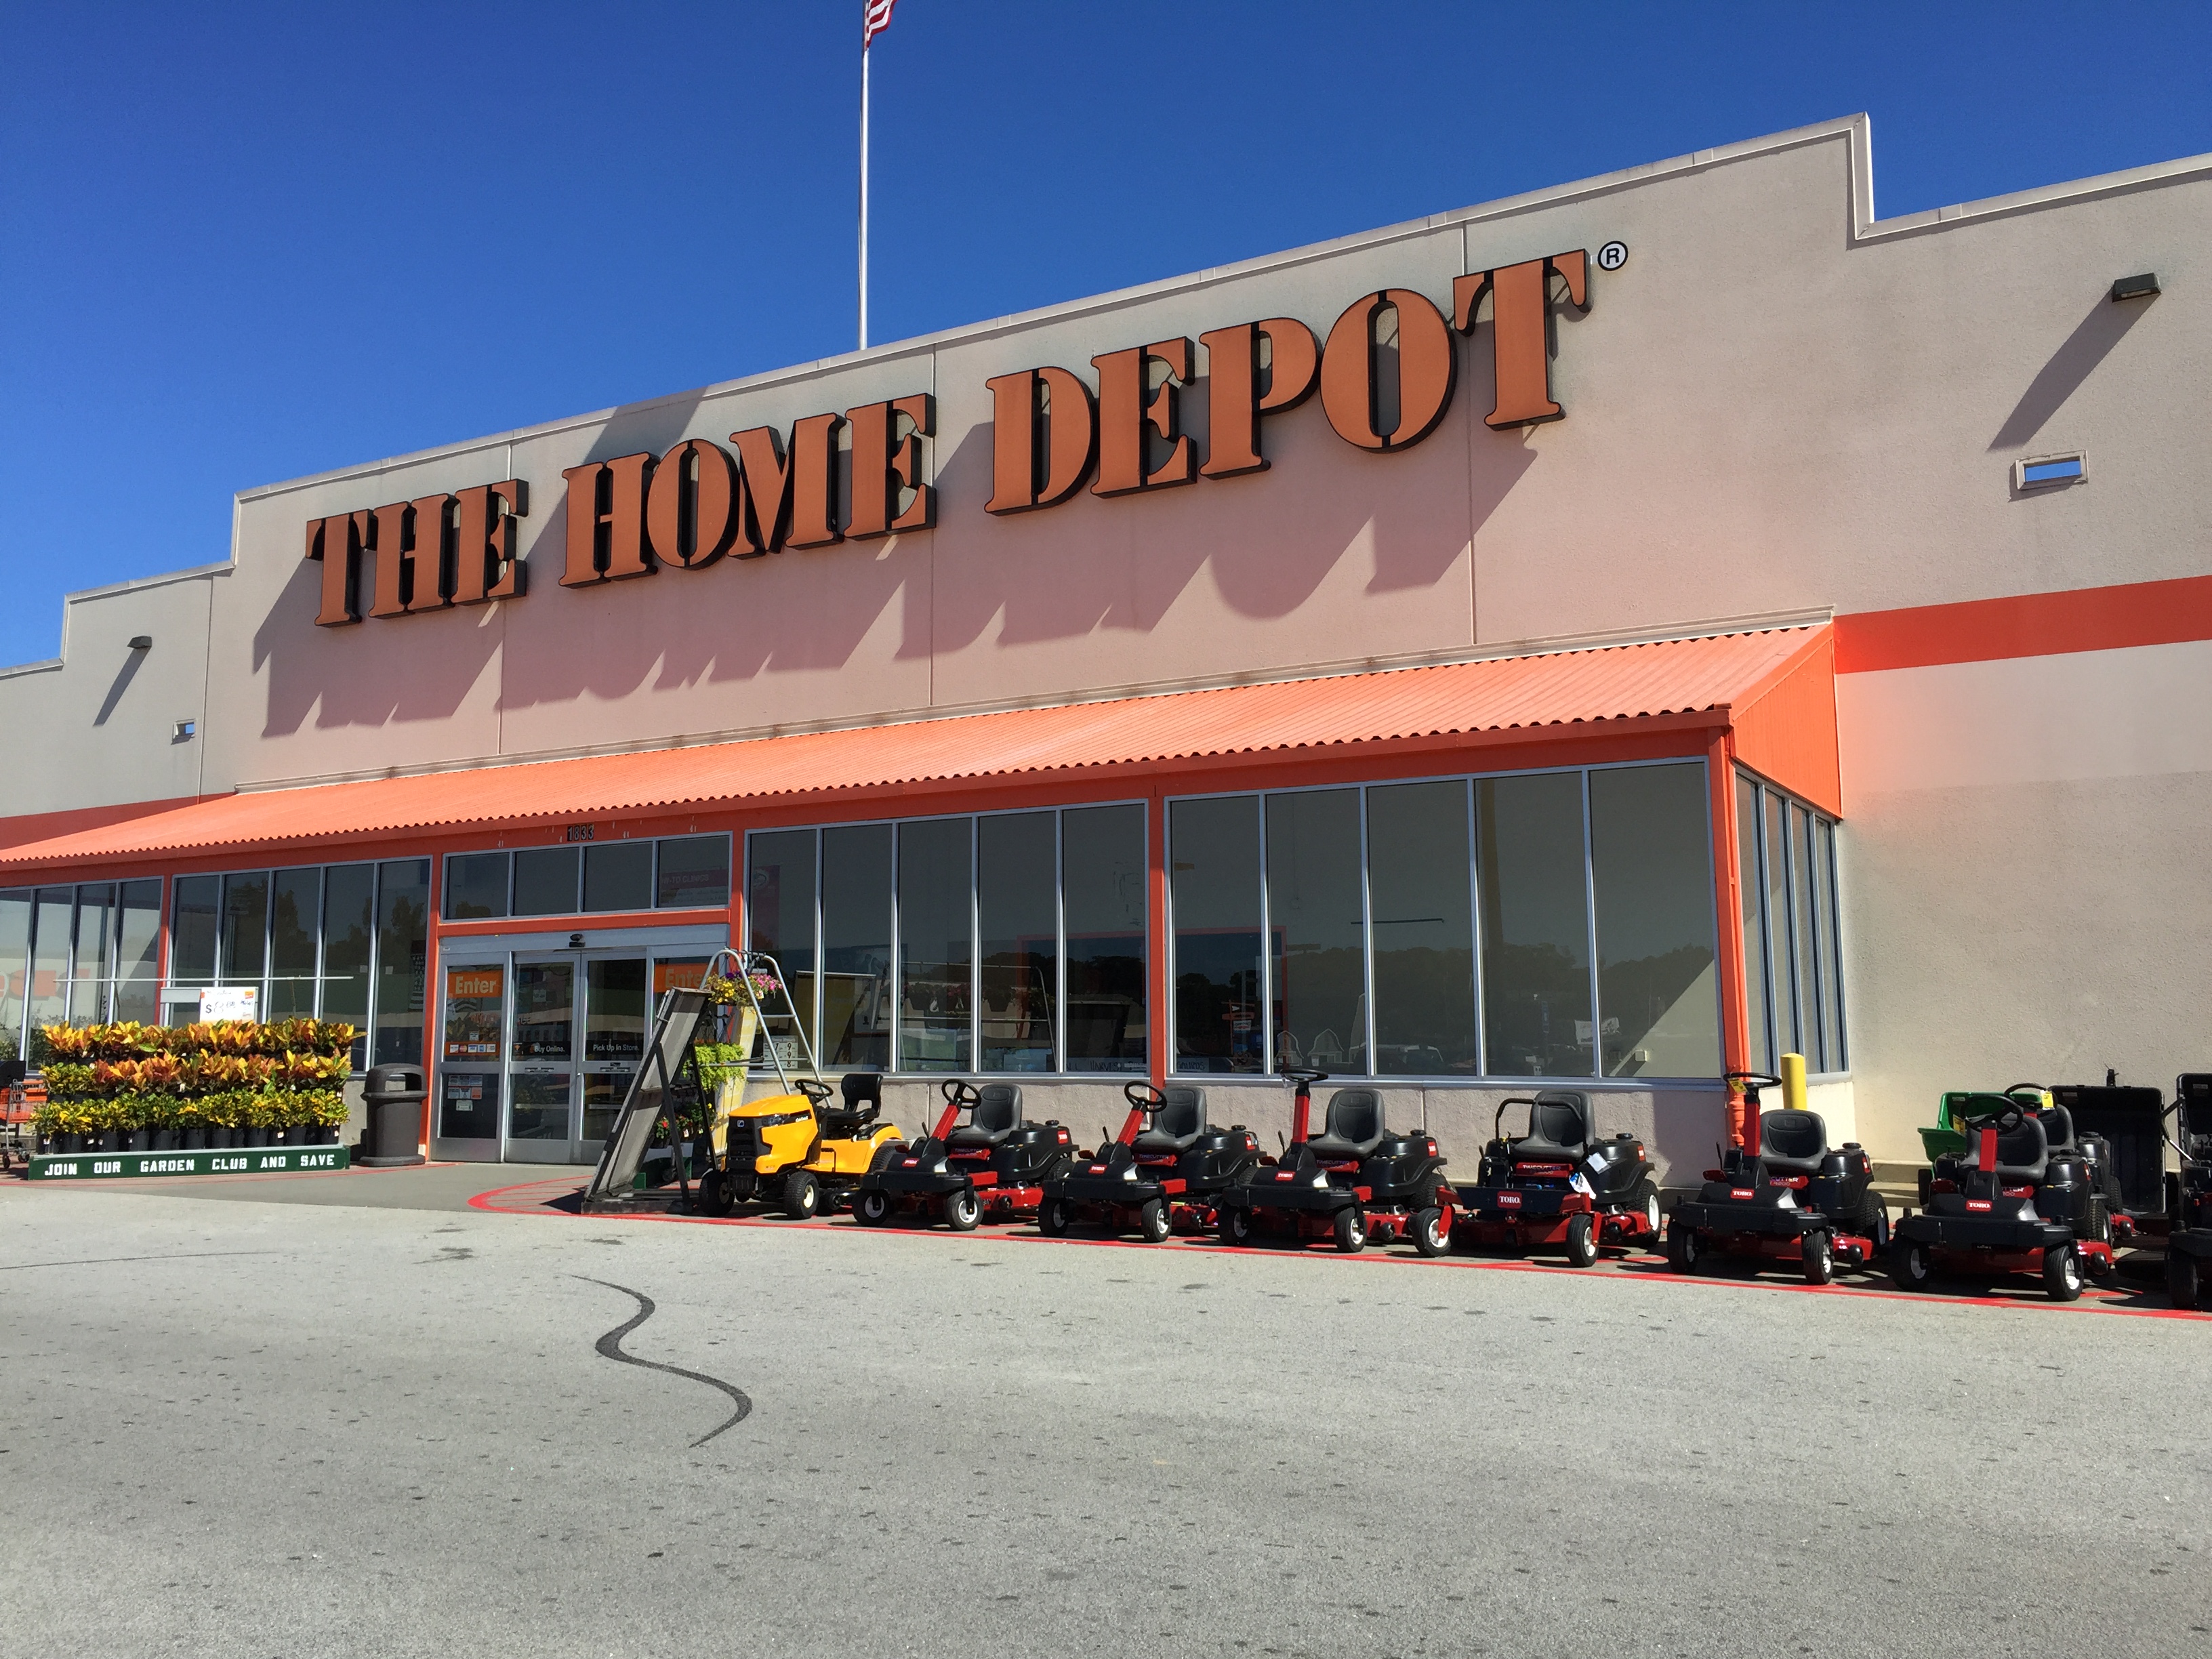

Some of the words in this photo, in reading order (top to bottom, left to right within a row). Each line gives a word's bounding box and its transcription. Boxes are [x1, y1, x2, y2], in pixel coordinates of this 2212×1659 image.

[306, 478, 529, 627] THE
[558, 392, 937, 588] HOME
[984, 248, 1593, 516] DEPOT
[568, 825, 594, 841] 1833
[455, 976, 497, 994] Enter
[534, 1045, 546, 1054] Buy
[787, 1042, 792, 1050] 9
[45, 1163, 77, 1176] JOIN
[94, 1162, 121, 1174] OUR
[140, 1159, 194, 1172] GARDEN
[211, 1158, 247, 1170] CLUB
[260, 1156, 286, 1168] AND
[300, 1154, 335, 1166] SAVE
[1499, 1195, 1521, 1204] TORO
